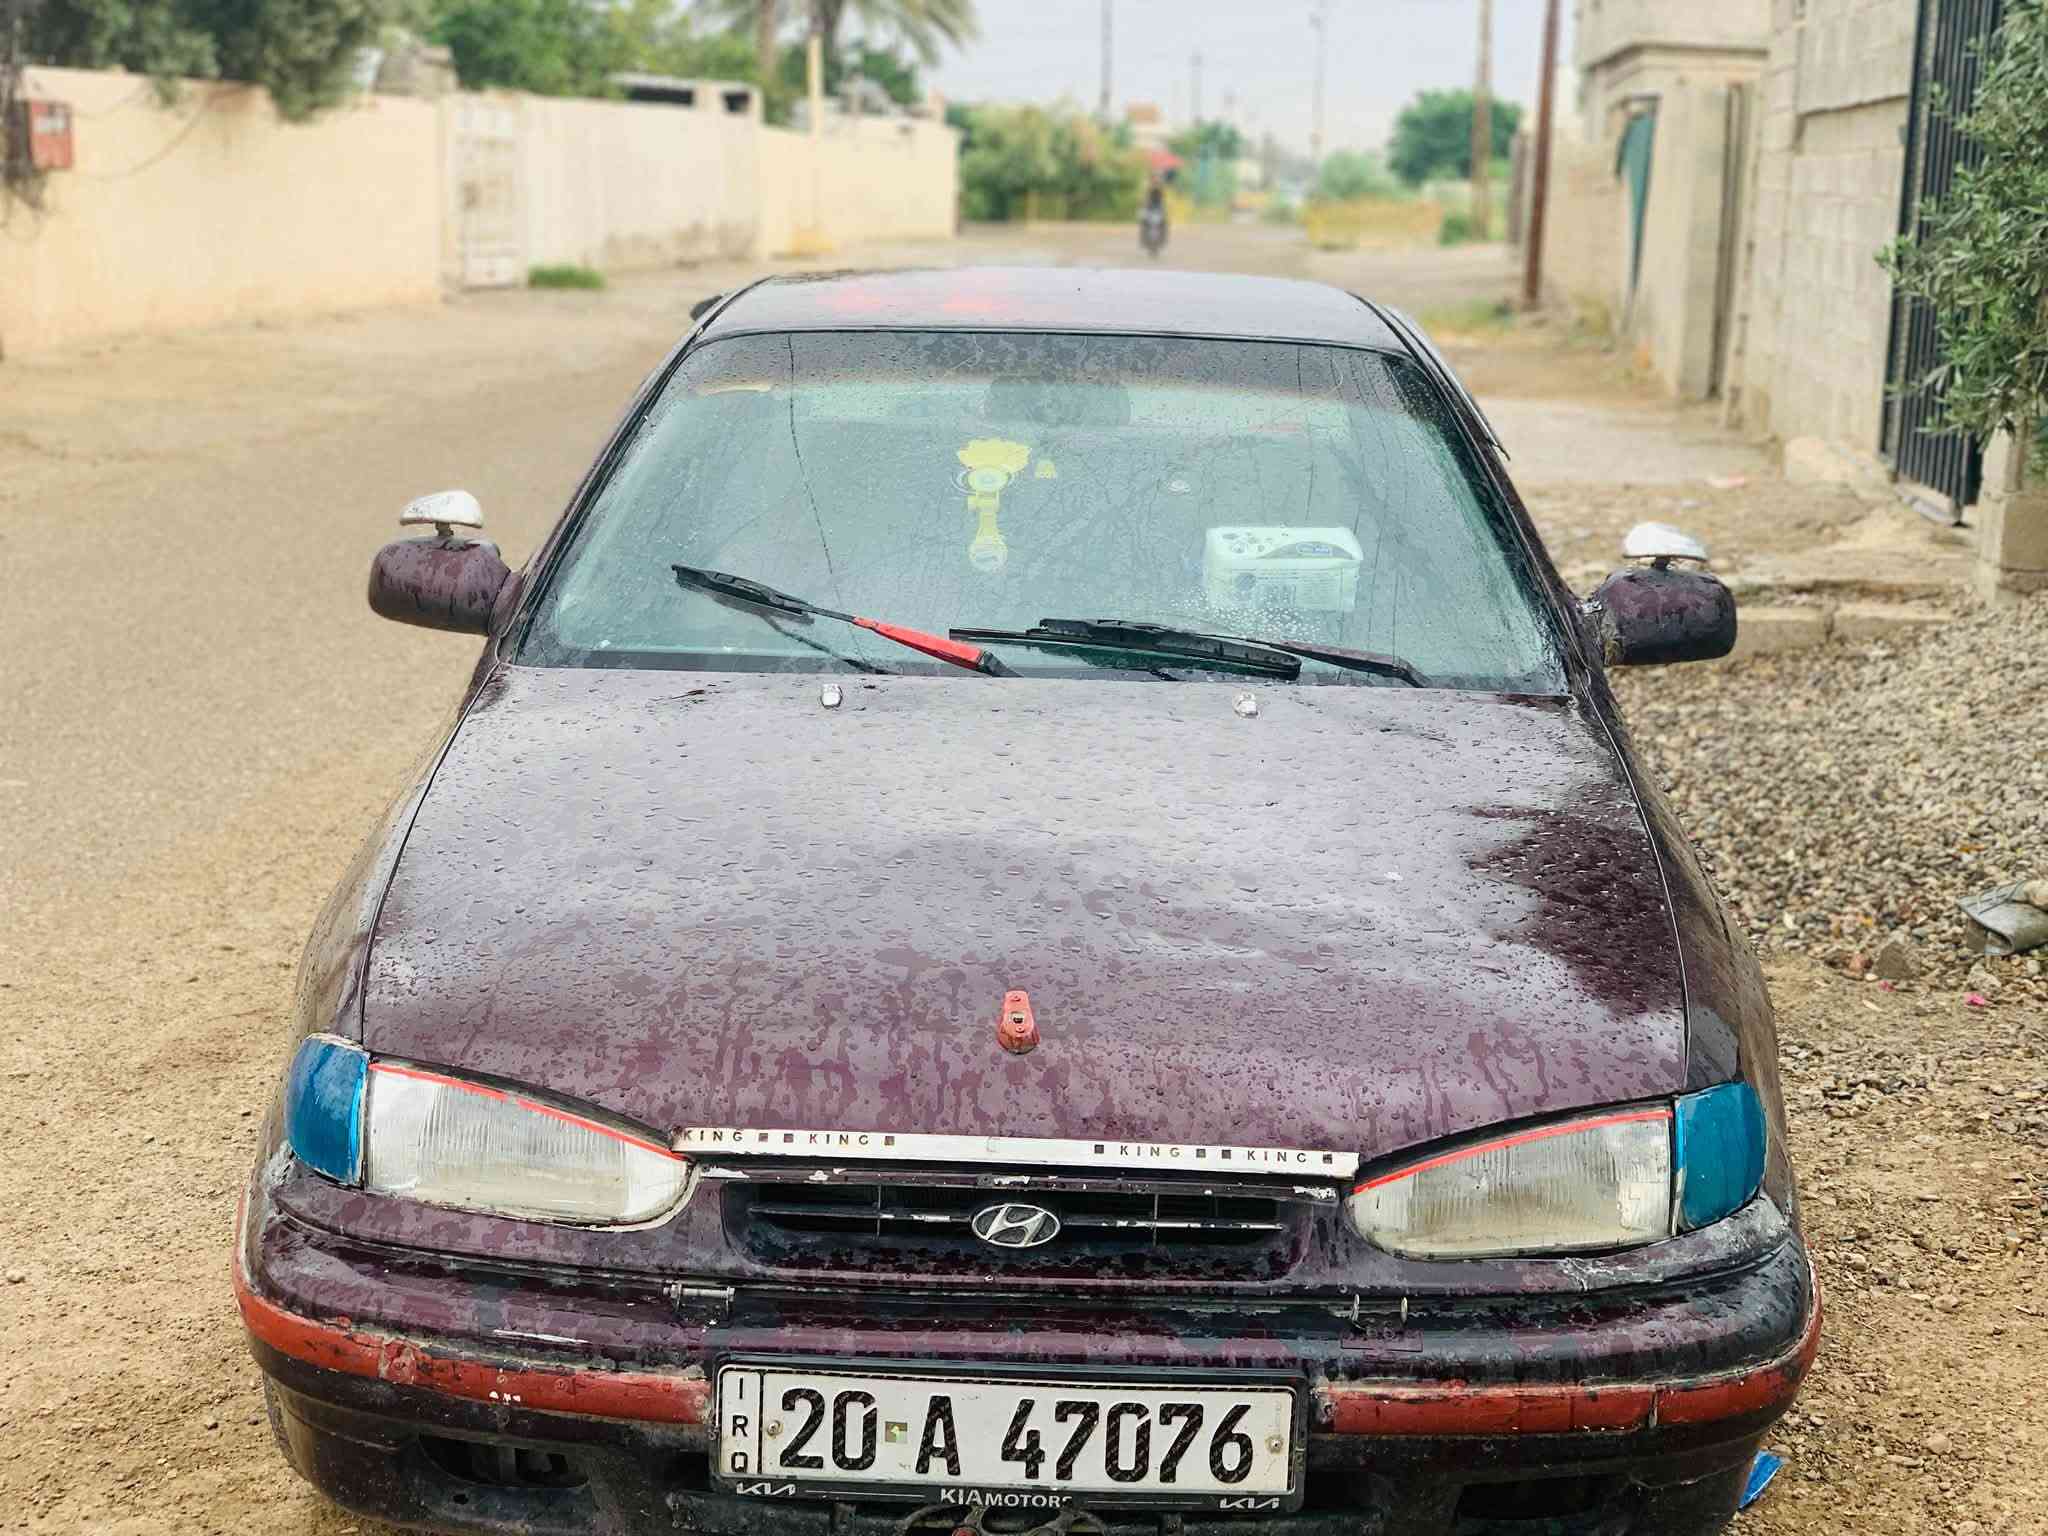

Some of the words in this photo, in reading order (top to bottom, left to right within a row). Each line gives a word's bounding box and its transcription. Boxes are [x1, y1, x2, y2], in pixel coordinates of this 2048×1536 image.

[684, 1129, 743, 1142] KING
[809, 1133, 869, 1145] KING
[1120, 1144, 1180, 1158] KING
[1247, 1150, 1306, 1163] KING
[780, 1388, 878, 1471] 20
[915, 1396, 961, 1476] A
[1001, 1398, 1253, 1484] 47076
